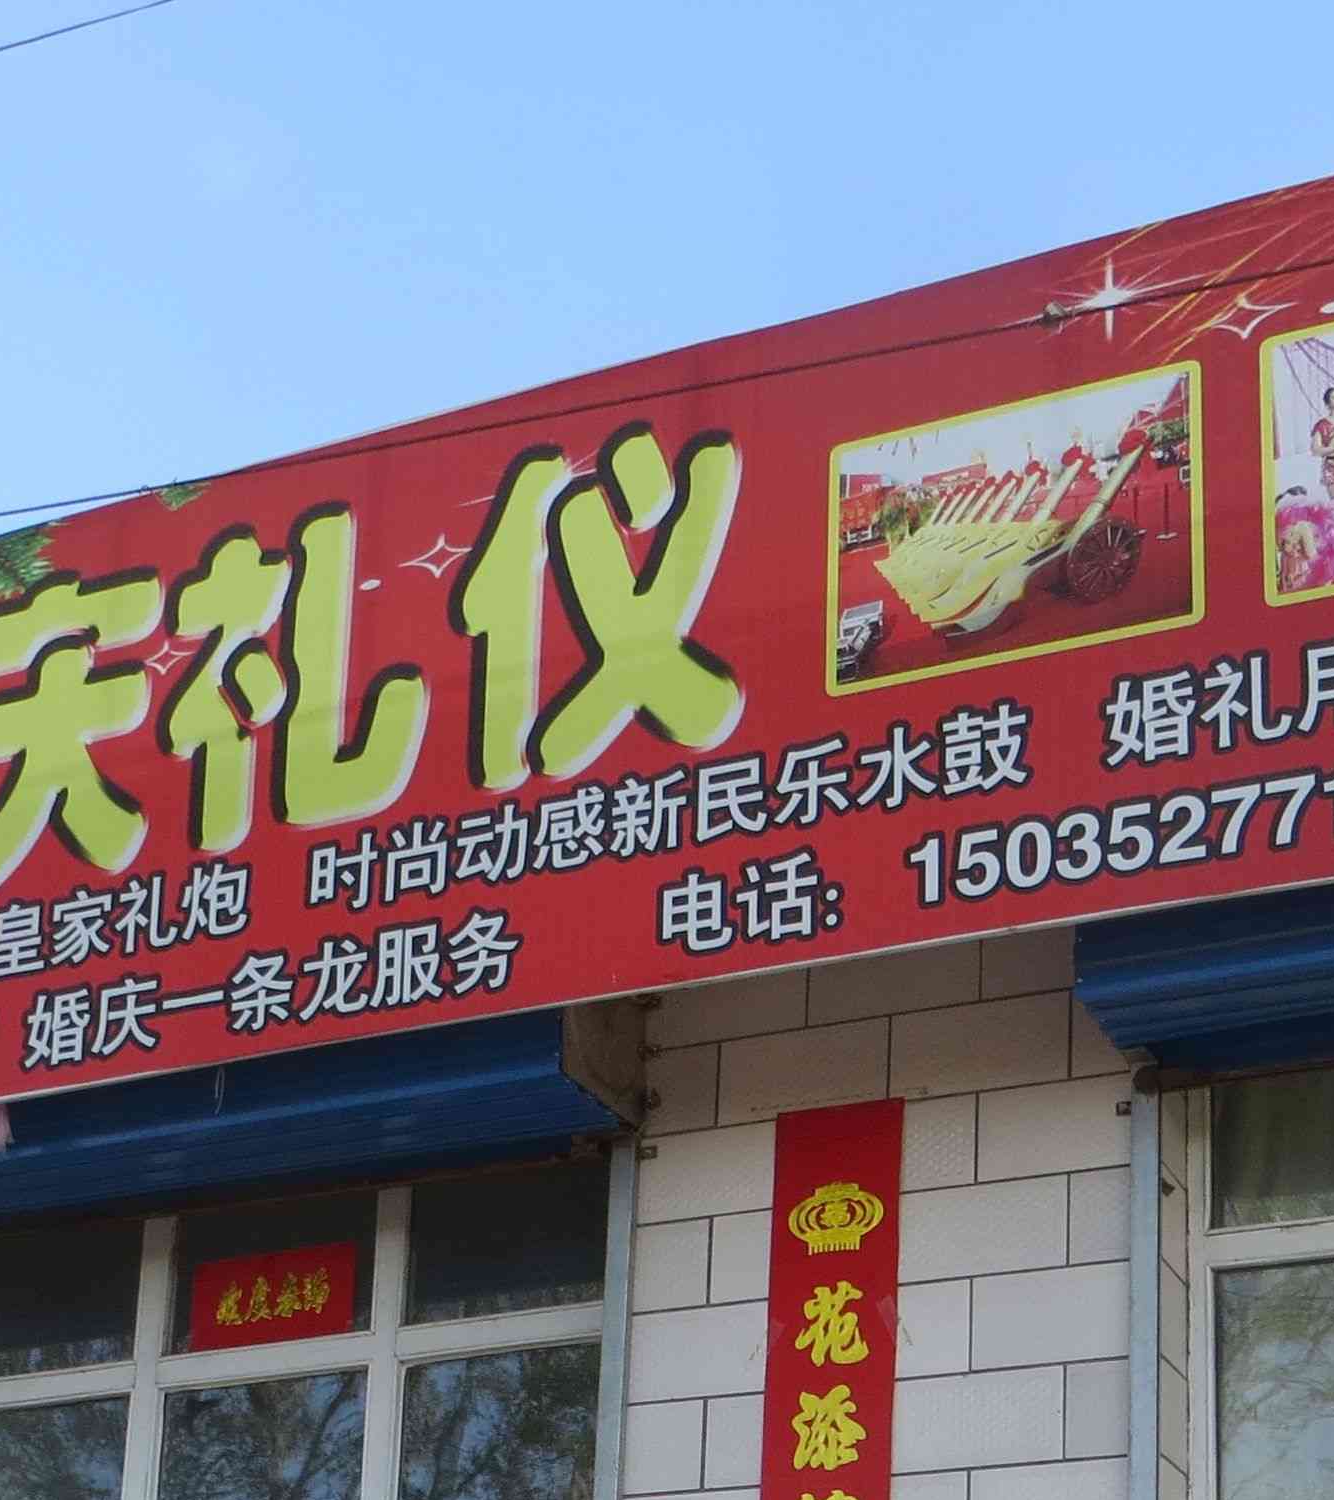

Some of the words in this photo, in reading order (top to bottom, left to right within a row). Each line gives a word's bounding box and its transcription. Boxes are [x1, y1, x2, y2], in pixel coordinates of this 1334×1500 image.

[311, 705, 1026, 908] 时尚动感新民乐水鼓
[25, 914, 517, 1067] 婚庆一条龙服务
